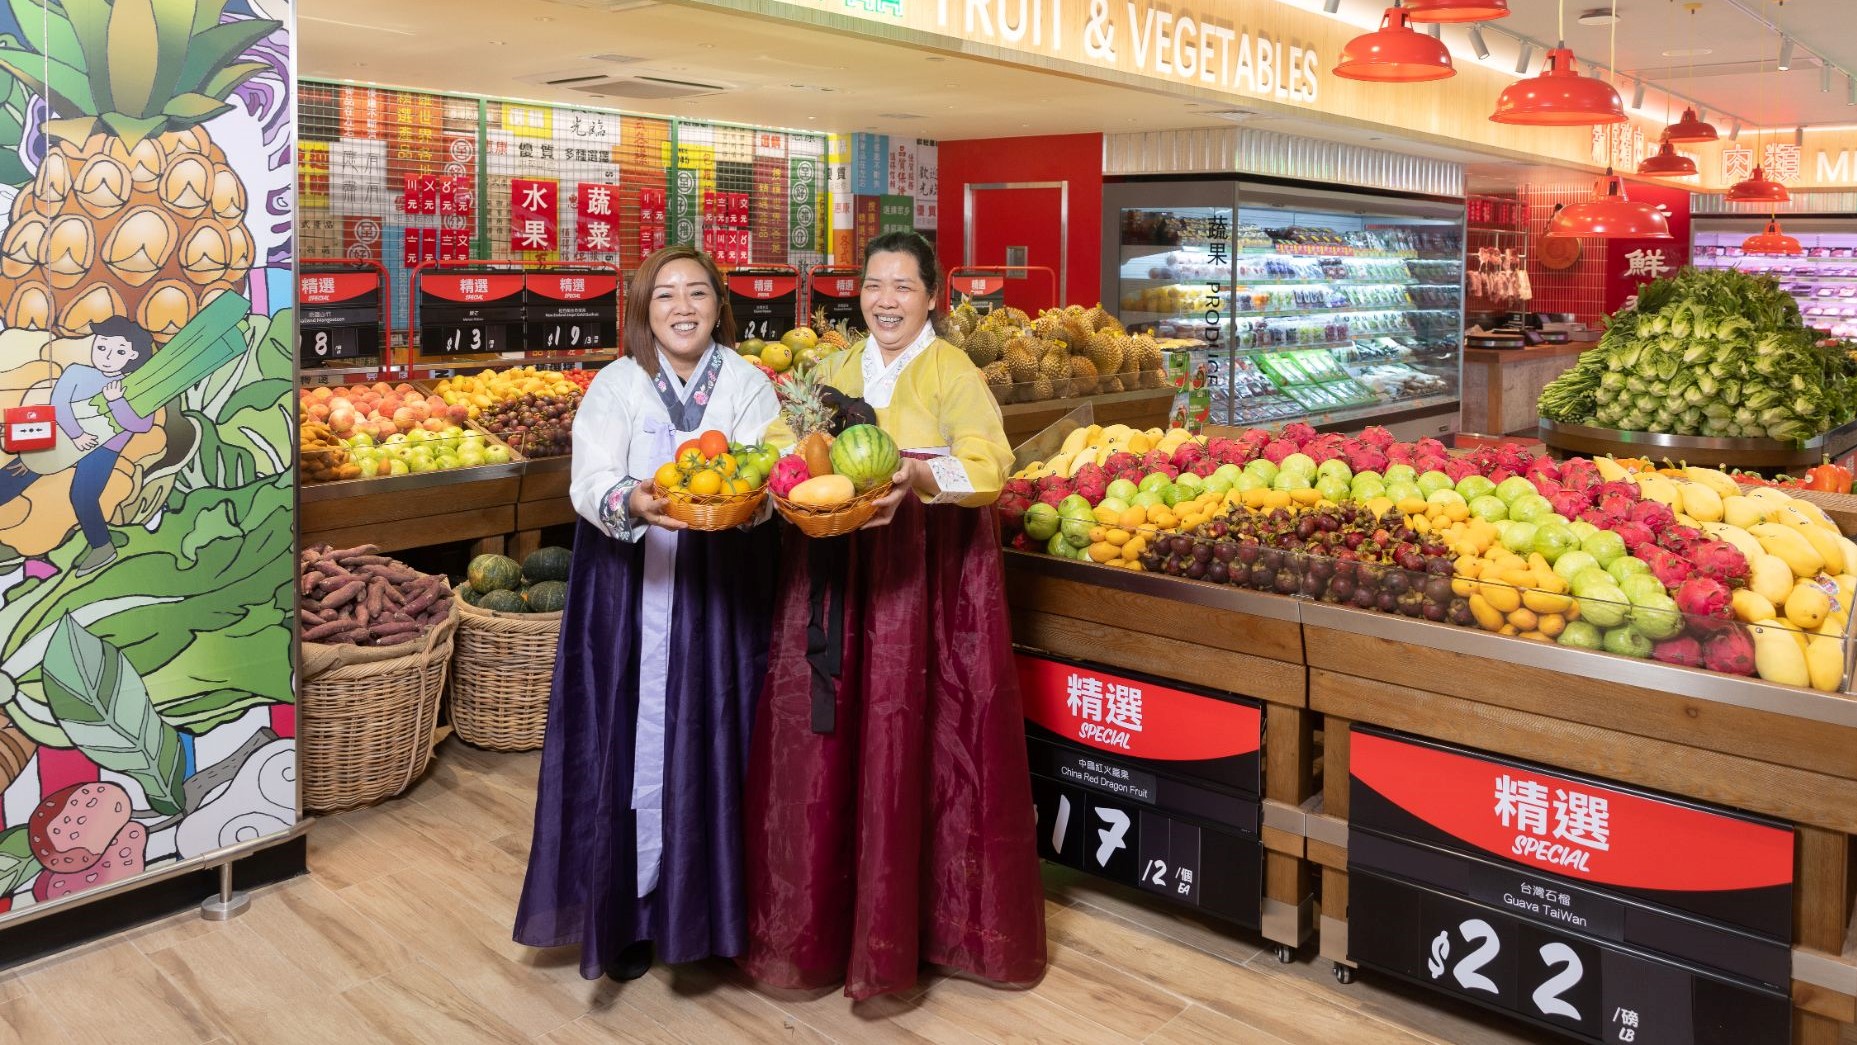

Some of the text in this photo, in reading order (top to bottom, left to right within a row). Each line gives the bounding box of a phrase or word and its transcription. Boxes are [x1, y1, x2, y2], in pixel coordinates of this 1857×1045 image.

[1083, 0, 1116, 63] &
[1127, 3, 1318, 103] VEGETABLES
[1722, 144, 1801, 185] 肉類
[521, 184, 548, 248] 水果
[587, 187, 611, 250] 蔬菜
[1207, 215, 1229, 265] 蔬果
[1624, 249, 1670, 278] 鮮
[301, 277, 335, 294] 精選
[460, 278, 488, 293] 精選
[560, 278, 585, 292] 精選
[1067, 673, 1143, 732] 精選
[1078, 722, 1131, 750] SPECIAL
[1061, 766, 1148, 799] China Red Dragon Fruit
[1494, 775, 1610, 852] 精選
[1511, 835, 1591, 873] SPECIAL
[1177, 882, 1191, 896] EA
[1520, 882, 1571, 906] 台灣石榴
[1503, 893, 1588, 928] Guava TaiWan
[1618, 1028, 1635, 1043] LB
